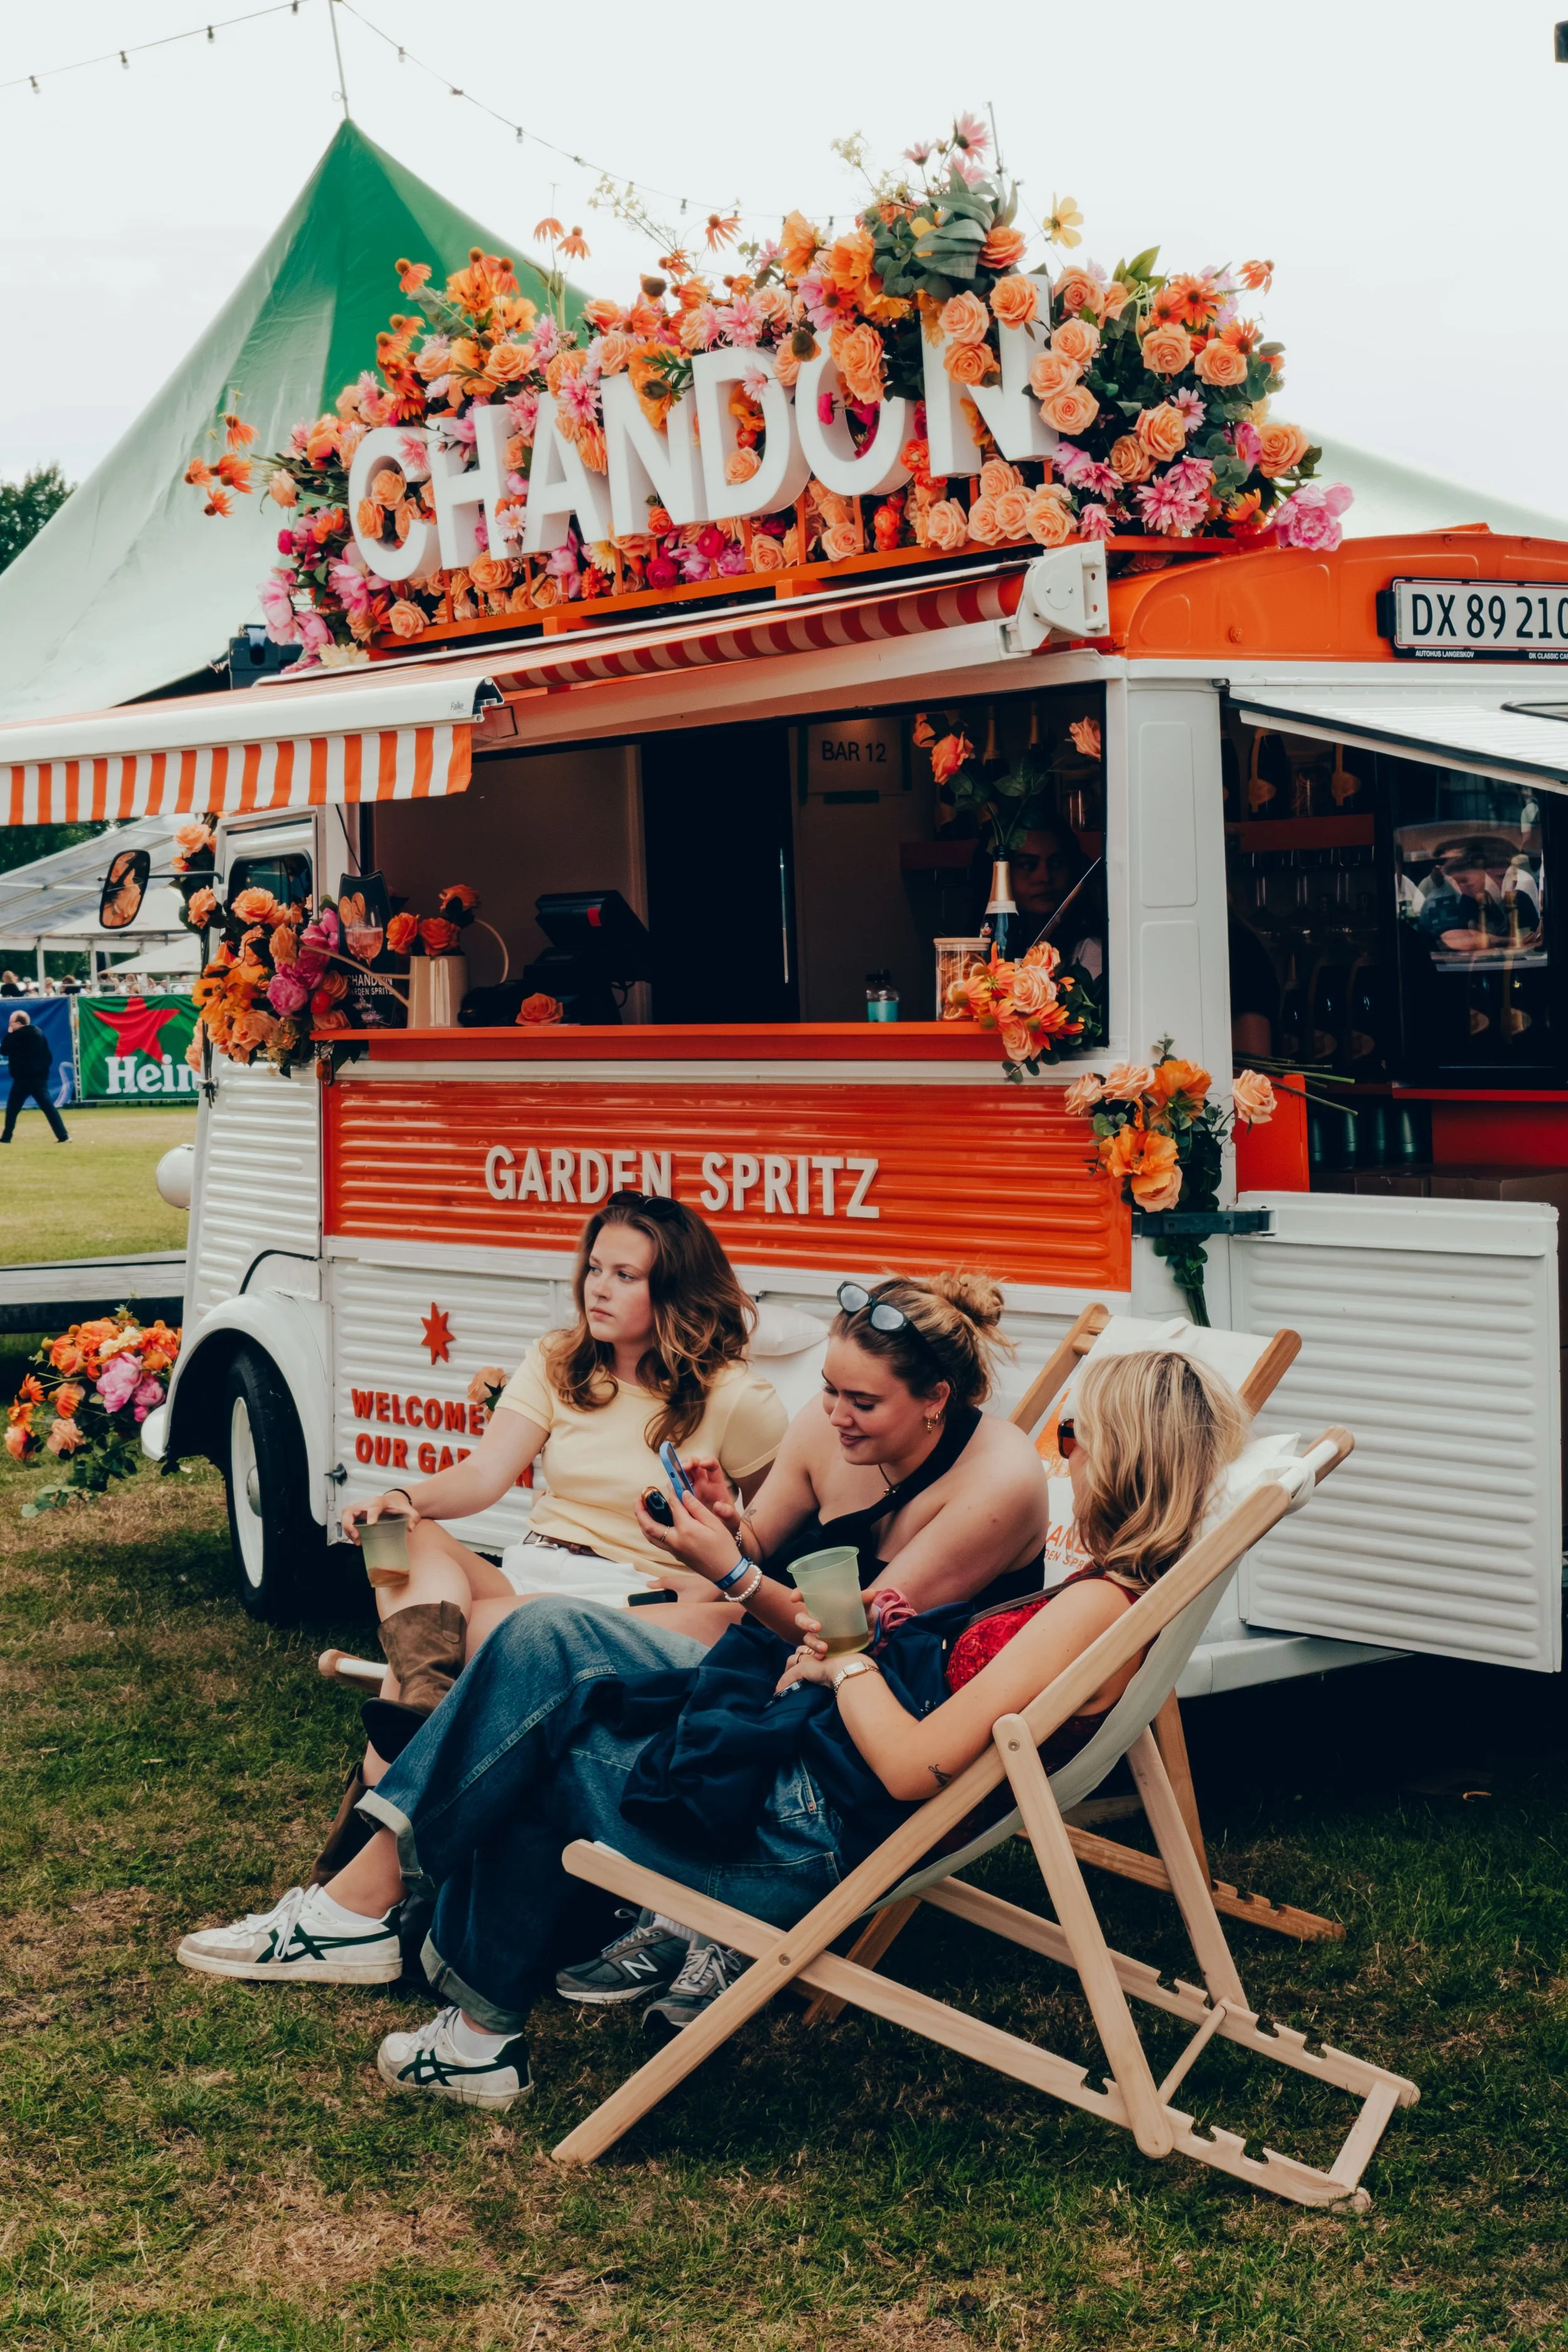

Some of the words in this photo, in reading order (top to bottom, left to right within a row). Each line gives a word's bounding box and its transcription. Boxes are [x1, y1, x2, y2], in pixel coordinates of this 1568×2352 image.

[348, 272, 1059, 581] CHANDON
[1412, 593, 1457, 637] DX
[1466, 593, 1506, 639] 89
[1516, 596, 1568, 639] 210
[822, 740, 860, 761] BAR
[865, 743, 887, 762] 12
[484, 1145, 672, 1204] GARDEN
[700, 1152, 879, 1218] SPRITZ
[351, 1388, 484, 1436] WELCOME
[355, 1433, 408, 1470] OUR
